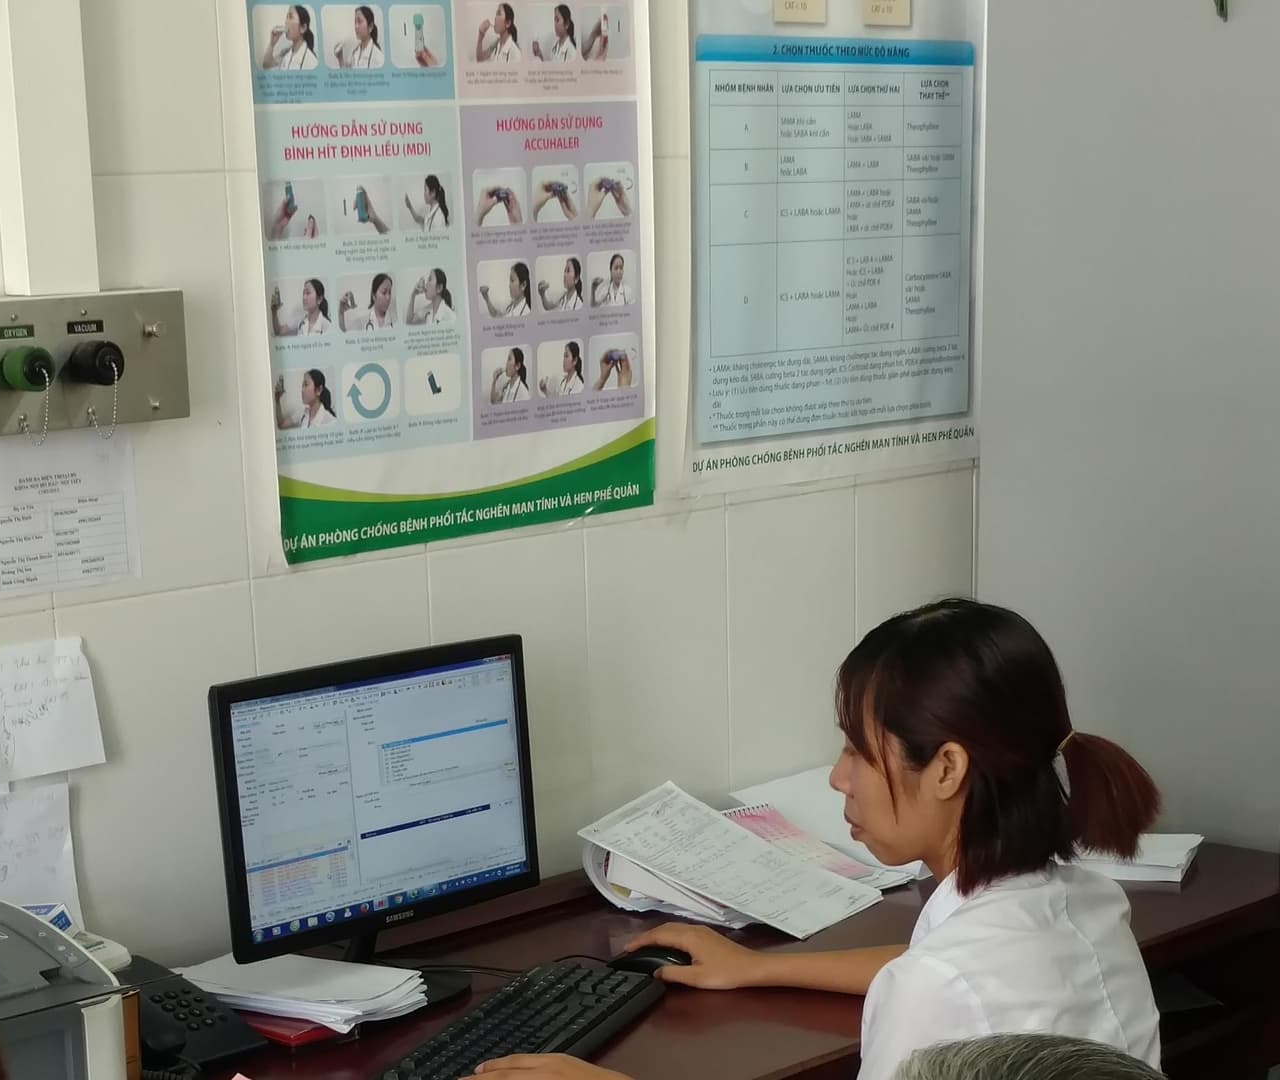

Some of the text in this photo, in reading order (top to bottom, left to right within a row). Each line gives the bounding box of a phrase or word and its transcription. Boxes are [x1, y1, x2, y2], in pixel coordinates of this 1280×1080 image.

[781, 44, 803, 57] CHỌN
[805, 43, 833, 57] THUỐC
[835, 46, 856, 57] THEO
[886, 46, 910, 59] NẶNG
[715, 82, 774, 94] NHÓM BỆNH NHÂN
[795, 84, 813, 95] CHỌN
[292, 119, 423, 140] HƯỚNG DẪN SỬ DỤNG
[497, 115, 535, 132] HƯỚNG
[538, 113, 558, 131] DẪN
[575, 116, 603, 132] DỤNG
[744, 123, 749, 132] A
[525, 136, 579, 151] ACCUHALER
[285, 144, 314, 161] BÌNH
[318, 143, 336, 159] HÍT
[341, 144, 371, 162] ĐỊNH
[403, 142, 431, 157] (MDI)
[3, 328, 28, 338] OXYGEN
[73, 323, 97, 333] VACUUM
[693, 459, 704, 475] DỰ
[706, 456, 718, 471] ÁN
[720, 453, 750, 470] PHÒNG
[752, 450, 781, 466] CHỐNG
[783, 447, 804, 463] BỆNH
[807, 443, 826, 458] PHỔI
[828, 441, 842, 455] TẮC
[872, 438, 890, 450] MẠN
[892, 434, 910, 448] TÍNH
[911, 431, 921, 444] VÀ
[922, 430, 937, 442] HEN
[938, 425, 952, 440] PHẾ
[953, 424, 974, 440] QUẢN
[284, 537, 298, 553] DỰ
[300, 532, 317, 550] ÁN
[319, 528, 359, 546] PHÒNG
[361, 521, 398, 539] CHỐNG
[400, 518, 427, 536] BỆNH
[430, 511, 454, 528] PHỔI
[456, 508, 474, 524] TẮC
[512, 501, 535, 517] MẠN
[536, 496, 558, 511] TÍNH
[560, 492, 572, 506] VÀ
[574, 491, 592, 505] HEN
[594, 485, 612, 502] PHẾ
[613, 482, 640, 500] QUẢN
[385, 909, 414, 924] SAMSUNG
